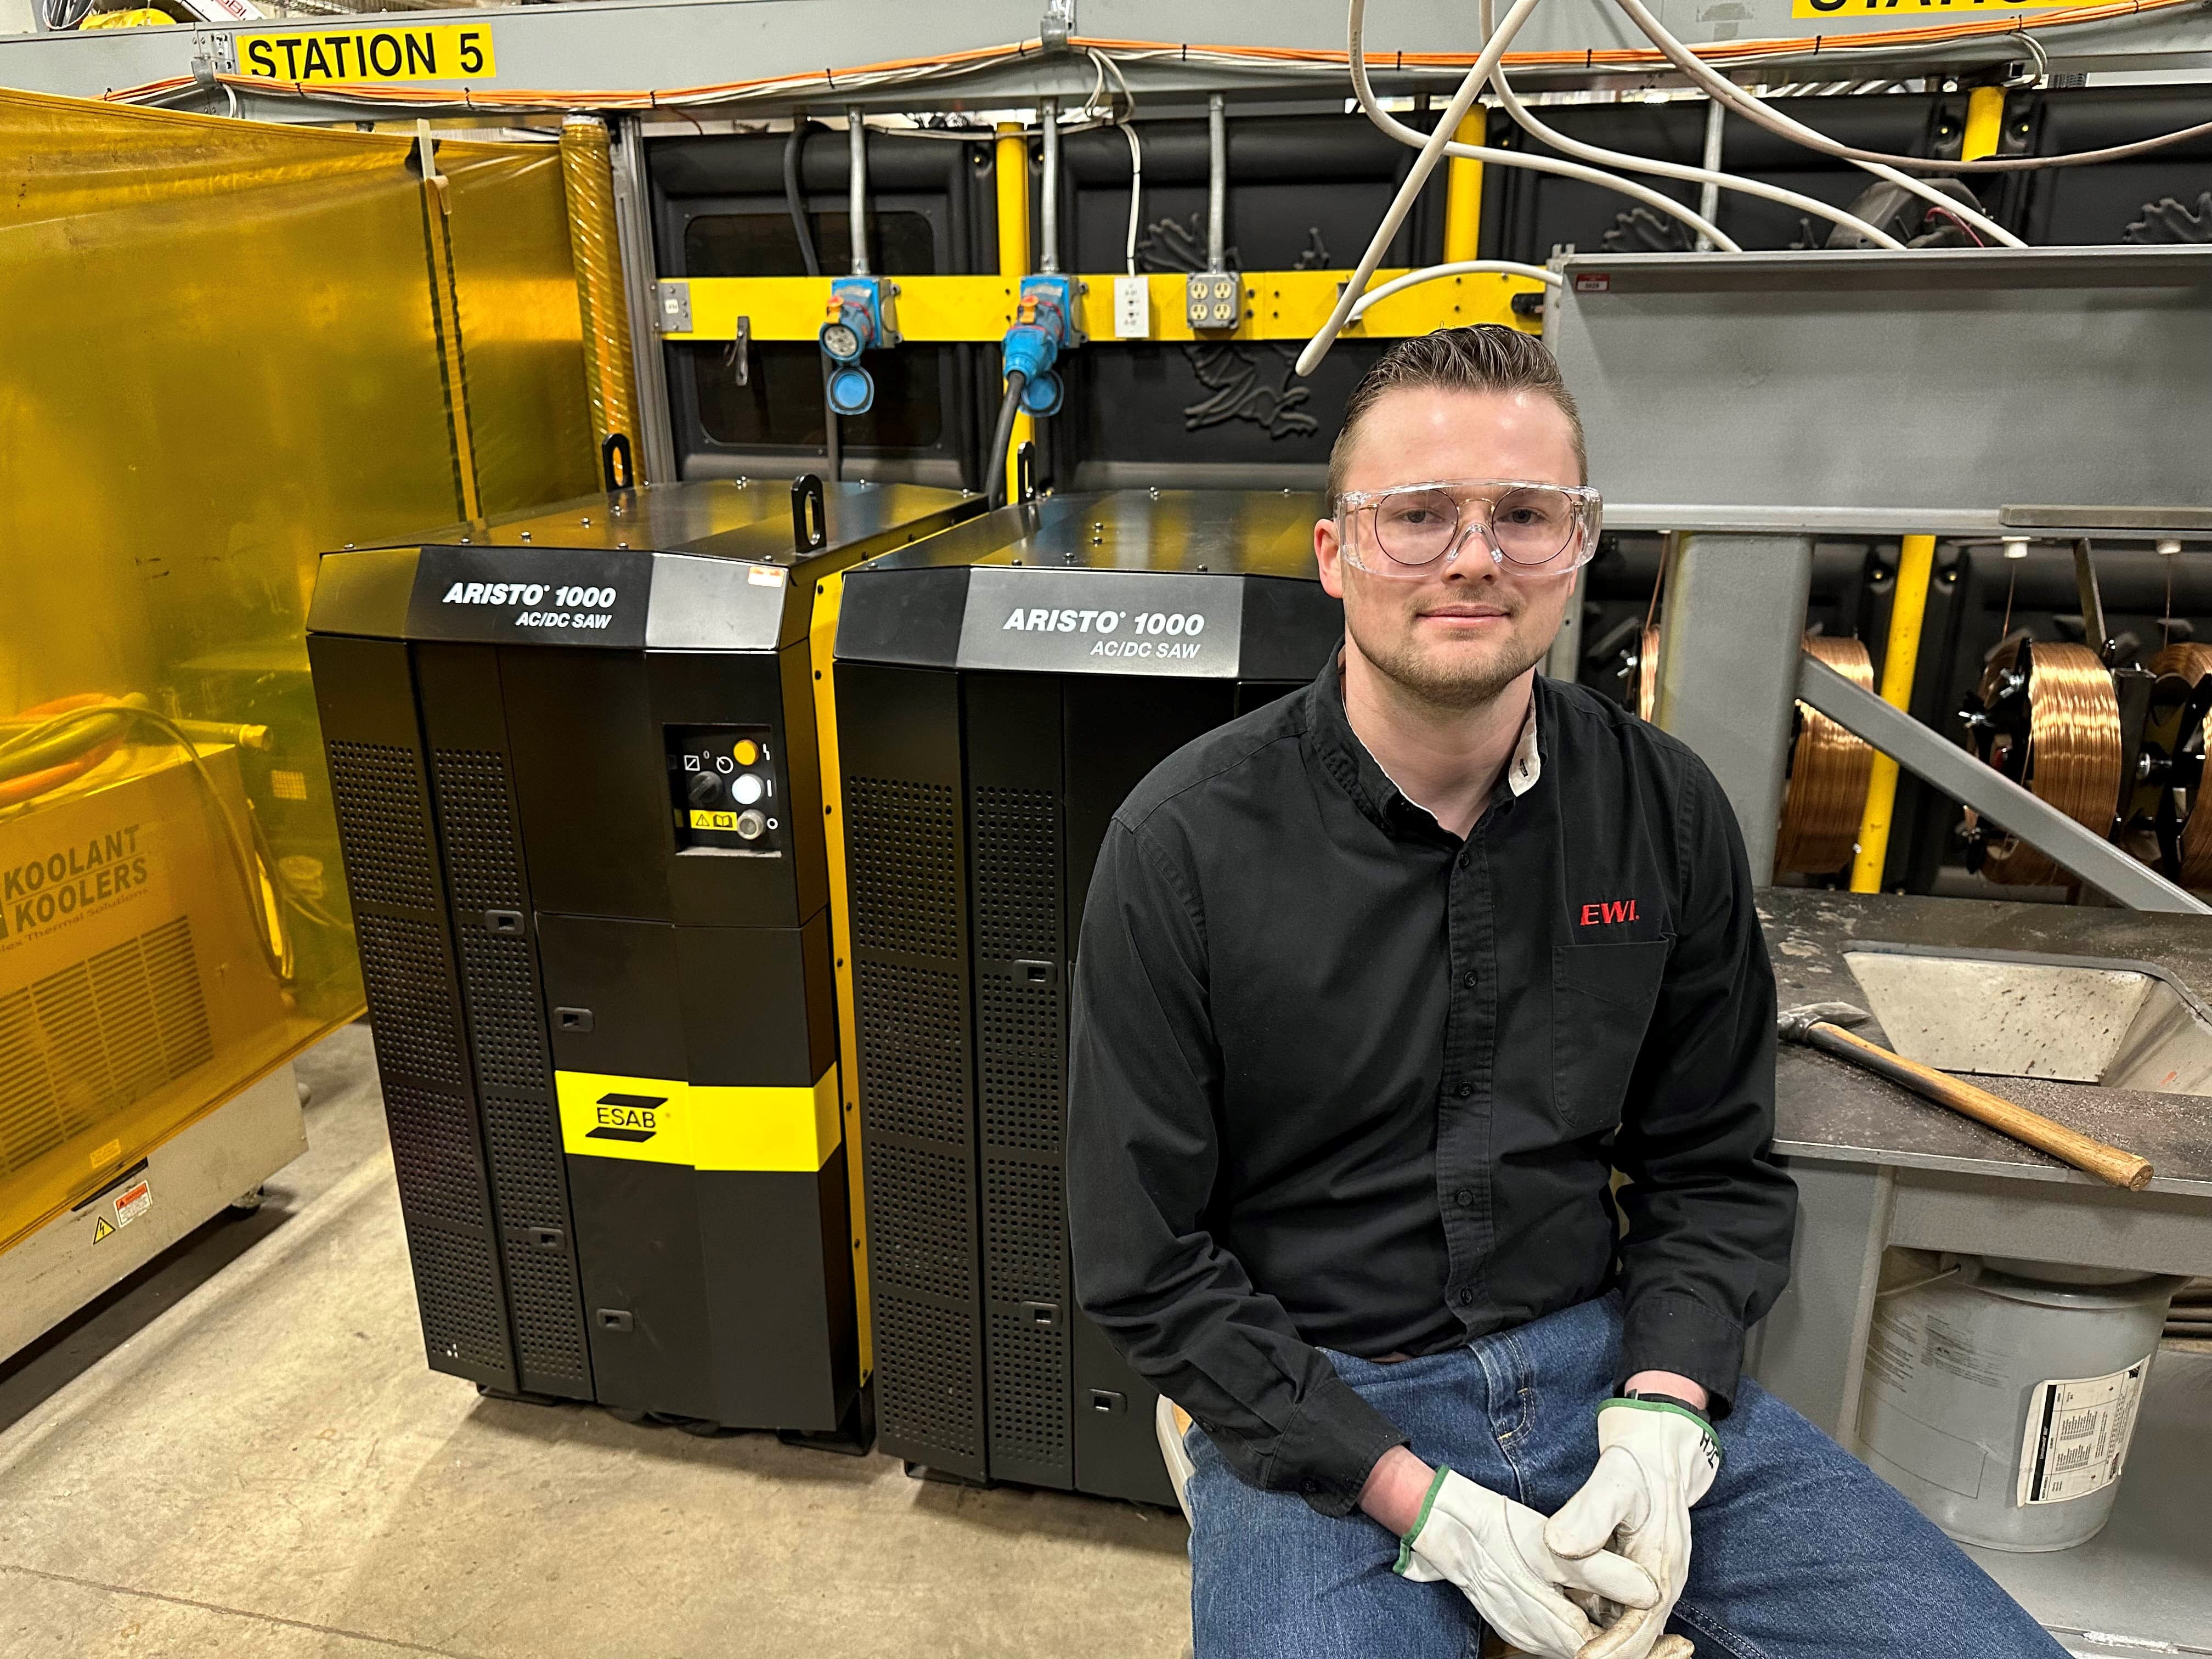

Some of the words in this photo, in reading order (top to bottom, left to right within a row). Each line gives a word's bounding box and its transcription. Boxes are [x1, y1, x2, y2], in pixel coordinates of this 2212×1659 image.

[248, 32, 437, 80] STATION
[460, 33, 483, 73] 5
[555, 586, 617, 608] 1000
[515, 612, 571, 628] AC/DC
[571, 613, 612, 629] SAW
[1134, 613, 1205, 636] 1000
[1090, 641, 1152, 657] AC/DC
[1155, 642, 1201, 658] SAW
[4, 824, 139, 901] KOOLANT
[15, 857, 148, 933] KOOLERS
[25, 913, 83, 941] Thermal
[86, 889, 149, 916] Solutions
[596, 1107, 656, 1128] ESAB
